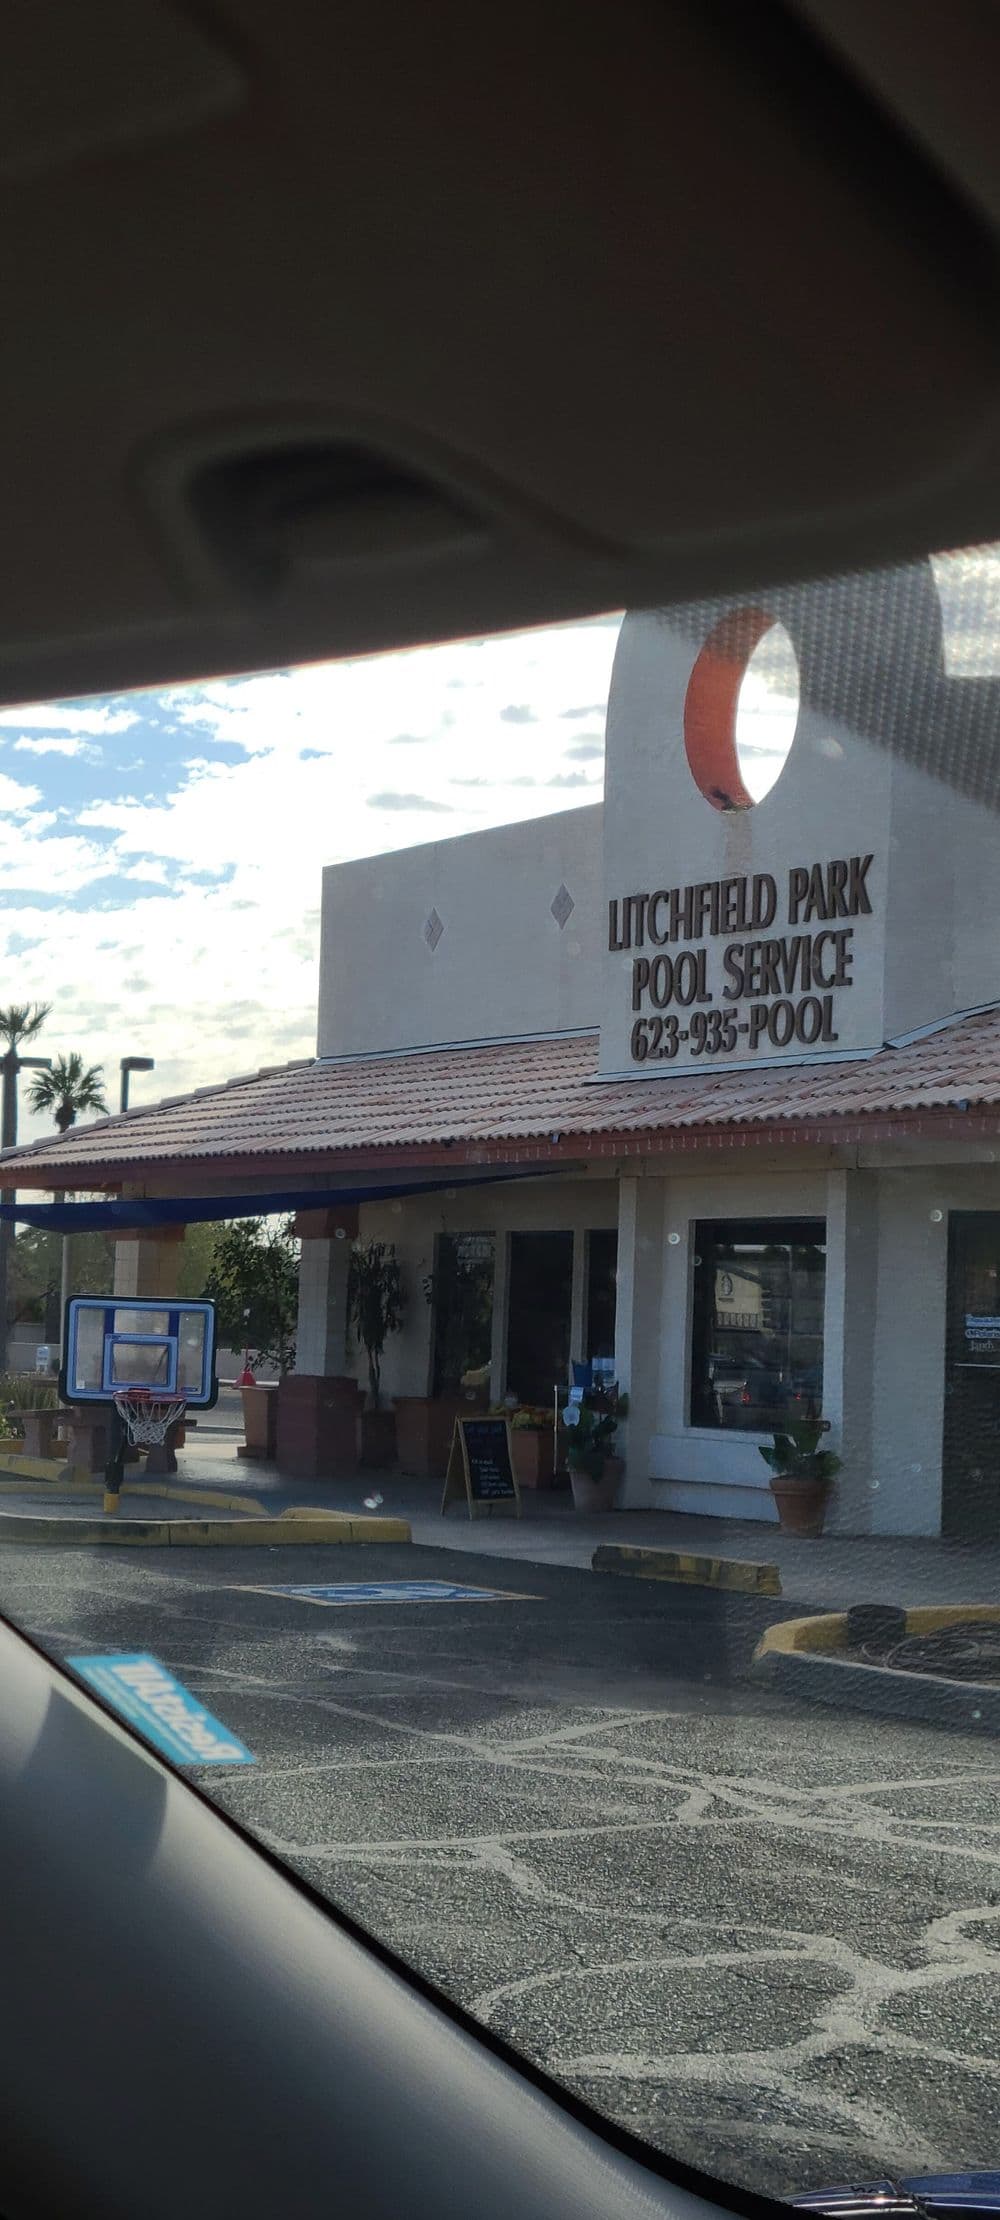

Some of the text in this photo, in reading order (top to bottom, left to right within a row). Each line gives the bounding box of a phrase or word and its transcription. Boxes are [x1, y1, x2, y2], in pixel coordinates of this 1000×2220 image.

[608, 854, 874, 951] LITCHFIELD PARK
[632, 928, 853, 1010] POOL SERVICE
[631, 995, 839, 1061] 623-935-POOL
